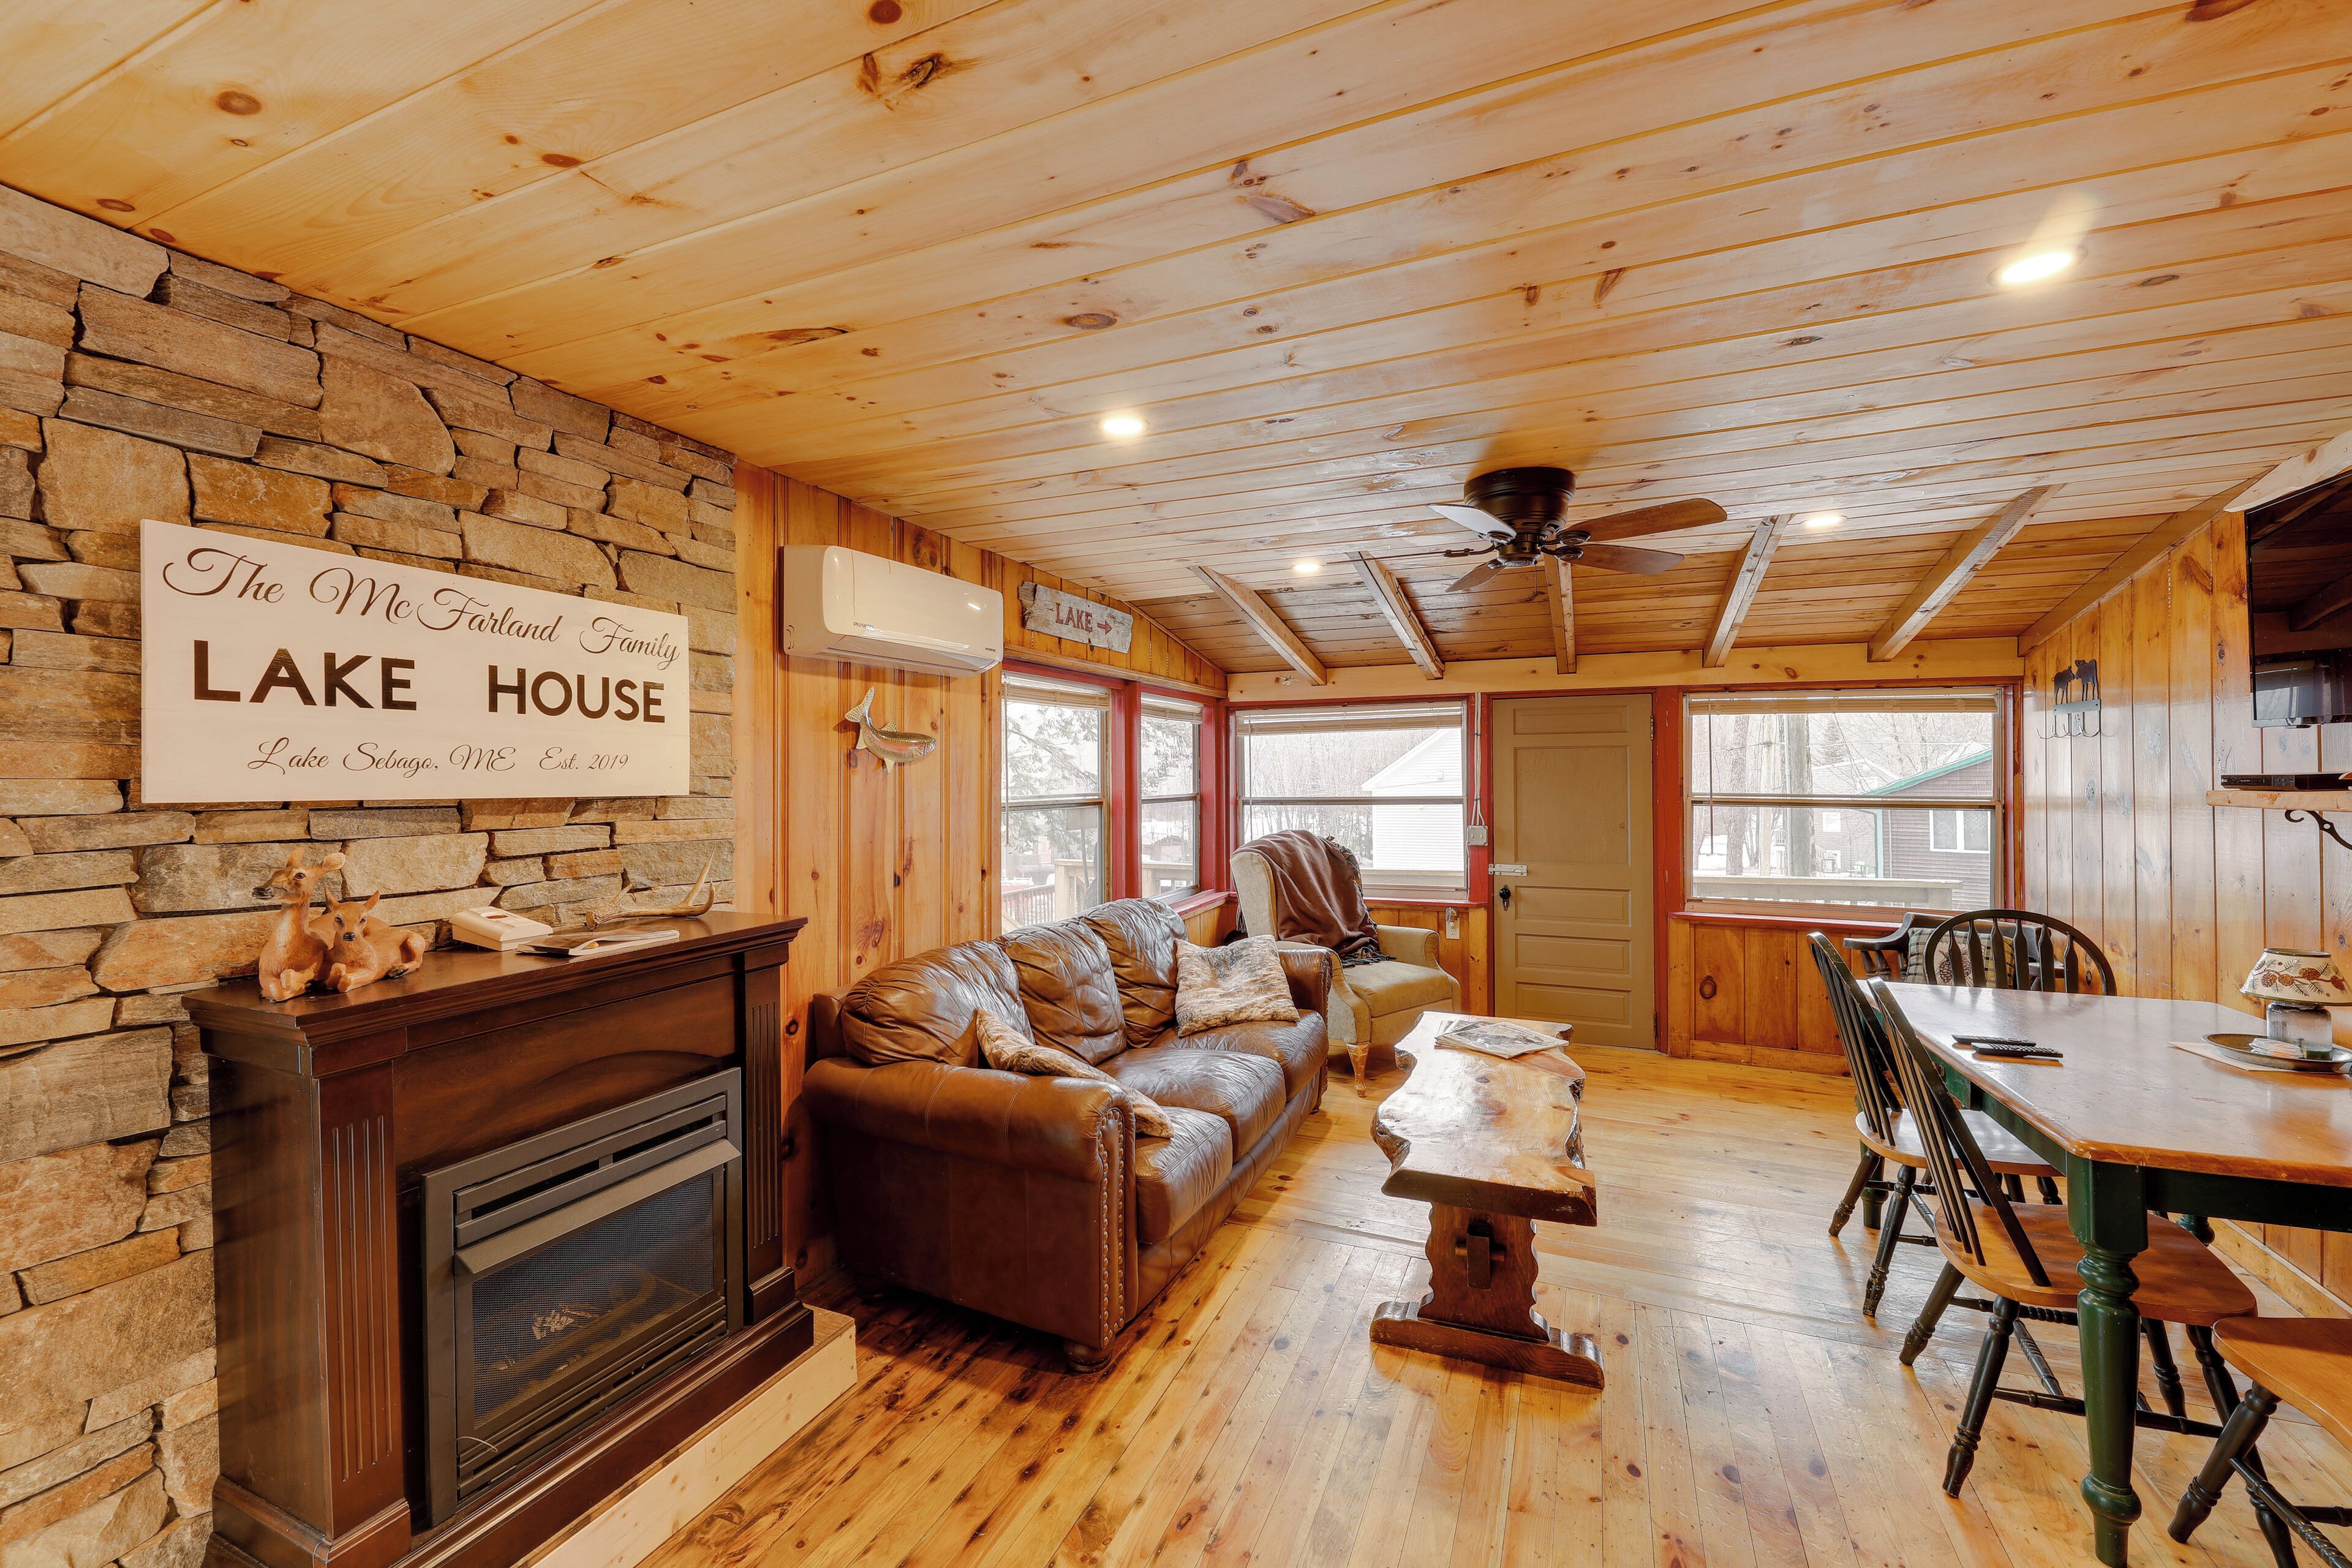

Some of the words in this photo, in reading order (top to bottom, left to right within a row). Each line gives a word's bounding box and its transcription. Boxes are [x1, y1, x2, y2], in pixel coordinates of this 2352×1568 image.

[162, 547, 285, 604] The
[579, 616, 680, 671] Family
[1055, 603, 1093, 632] LAKE
[194, 639, 417, 711] LAKE
[488, 664, 666, 723] HOUSE
[247, 737, 330, 775] Lake
[342, 742, 440, 778] Sebago,
[449, 744, 516, 772] ME
[539, 747, 579, 771] Est.
[587, 753, 630, 770] 2019
